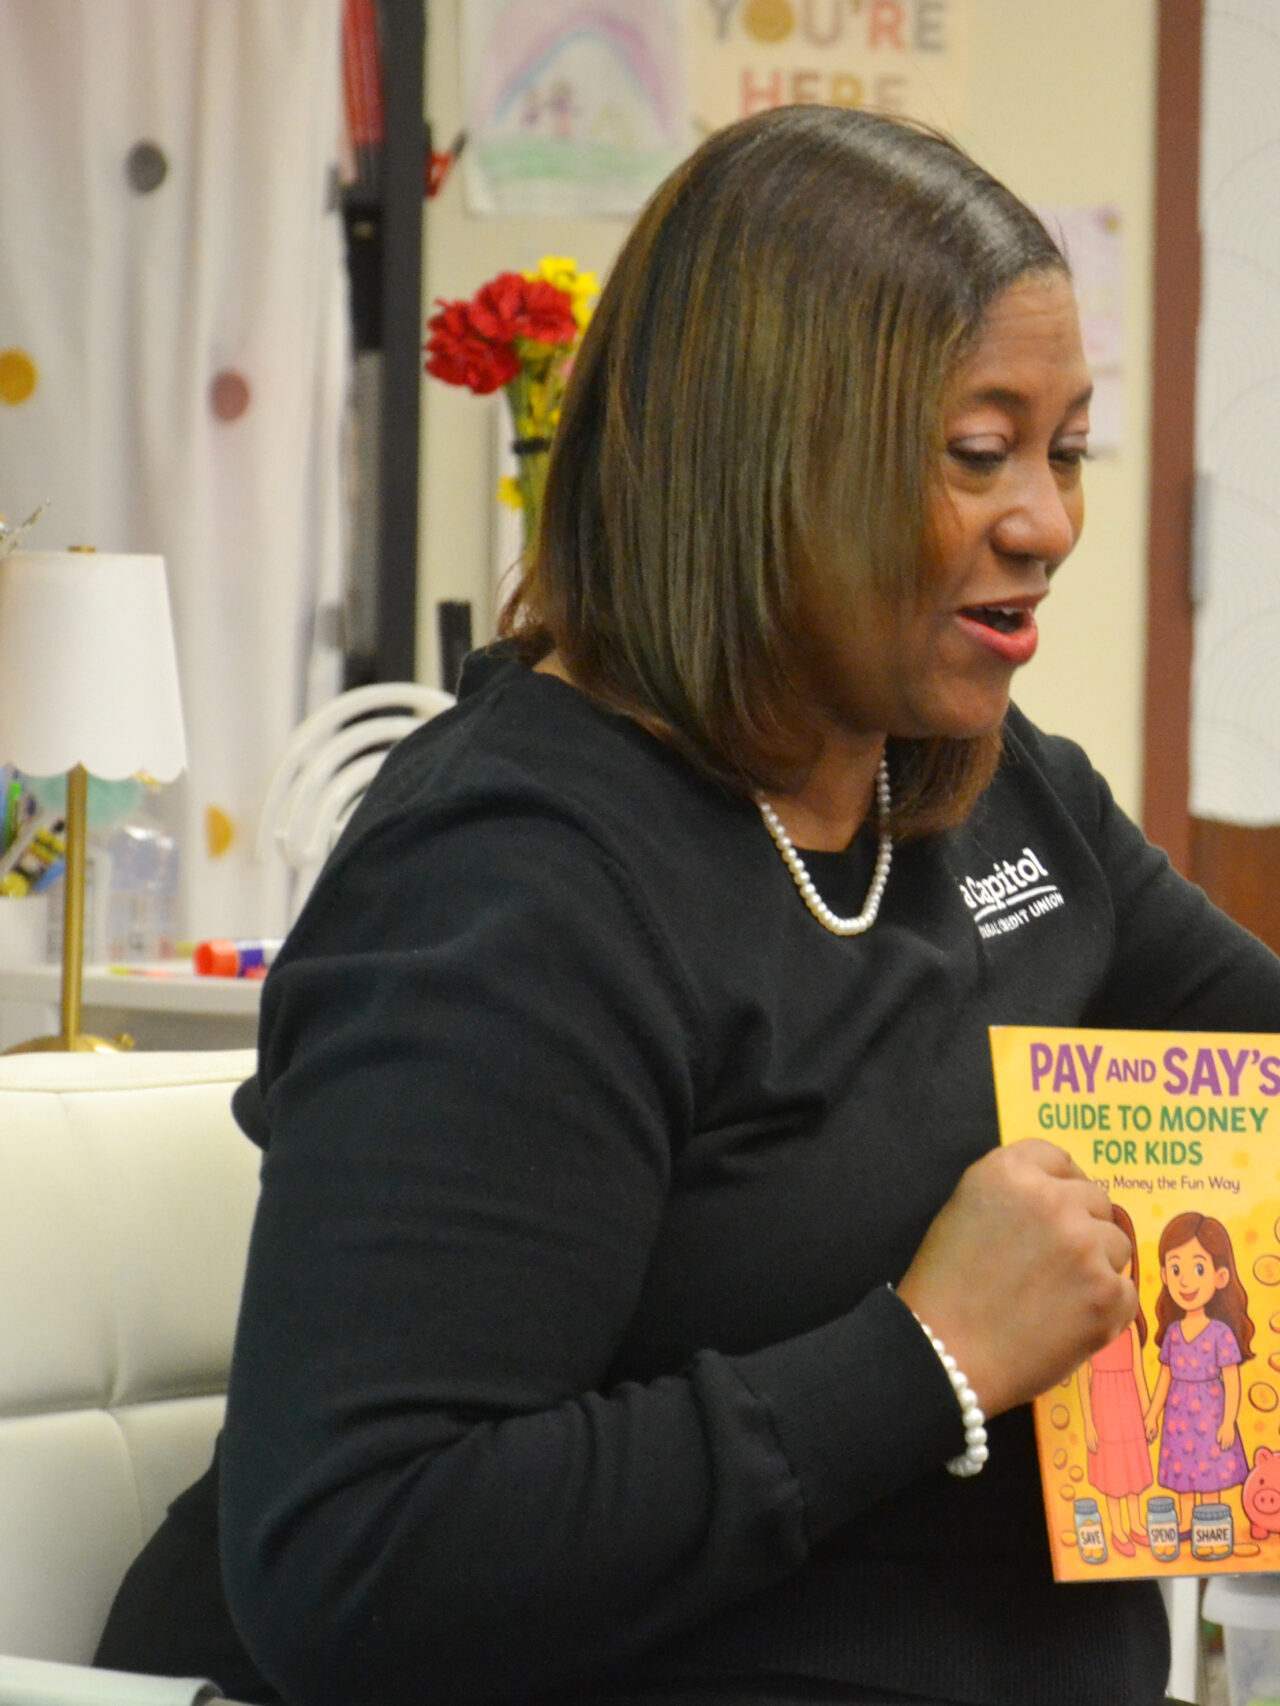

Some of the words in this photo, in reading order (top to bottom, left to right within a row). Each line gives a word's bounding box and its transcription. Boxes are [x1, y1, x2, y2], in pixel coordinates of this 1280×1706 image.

[965, 847, 1049, 909] Capitol
[1028, 892, 1065, 918] UNION
[1029, 1042, 1104, 1094] PAY
[1106, 1058, 1157, 1083] AND
[1038, 1103, 1110, 1131] GUIDE
[1117, 1105, 1151, 1131] TO
[1160, 1107, 1269, 1133] MONEY
[1093, 1139, 1137, 1165] FOR
[1145, 1141, 1203, 1166] KIDS
[1113, 1175, 1154, 1194] Money
[1157, 1176, 1177, 1190] the
[1180, 1175, 1204, 1190] Fun
[1208, 1176, 1240, 1194] Way
[1080, 1531, 1101, 1545] SAVE
[1150, 1527, 1176, 1543] SPEND
[1196, 1528, 1229, 1542] SHARE
